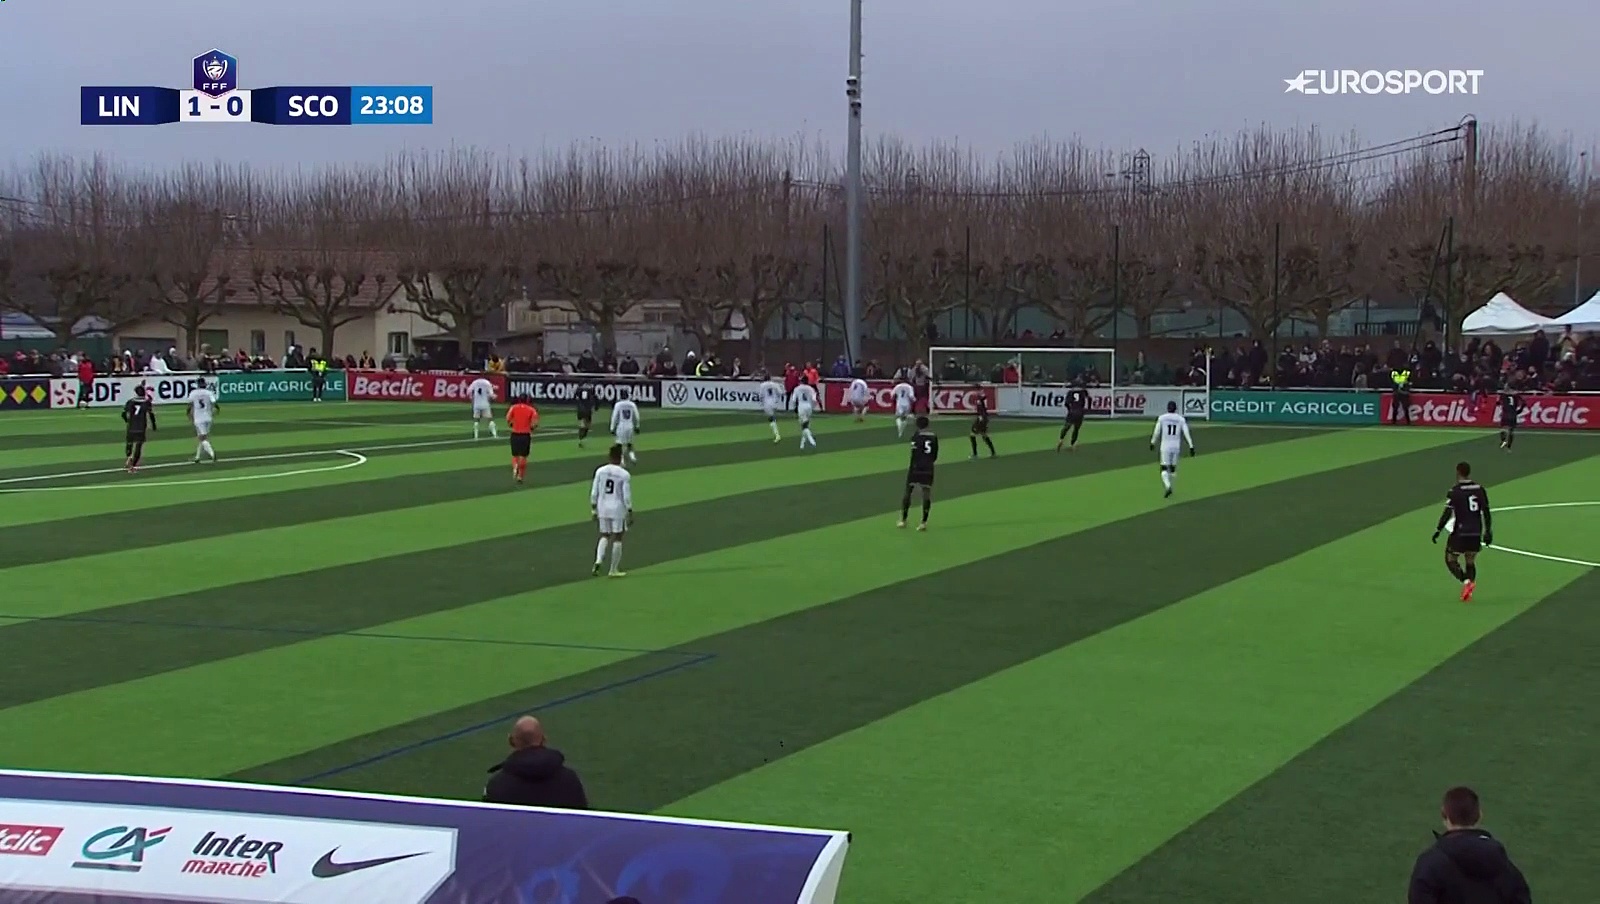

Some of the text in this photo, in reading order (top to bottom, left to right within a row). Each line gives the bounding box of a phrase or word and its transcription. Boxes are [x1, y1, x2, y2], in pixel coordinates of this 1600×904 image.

[83, 382, 121, 402] DF
[220, 380, 264, 394] CRÉDIT
[267, 380, 343, 392] AGRICLE
[353, 376, 424, 396] Betclic
[1211, 398, 1374, 415] CRÉDIT AGRICOLE
[1167, 424, 1177, 436] 11
[924, 440, 932, 454] 5
[605, 478, 614, 494] 9
[1468, 495, 1479, 512] 6
